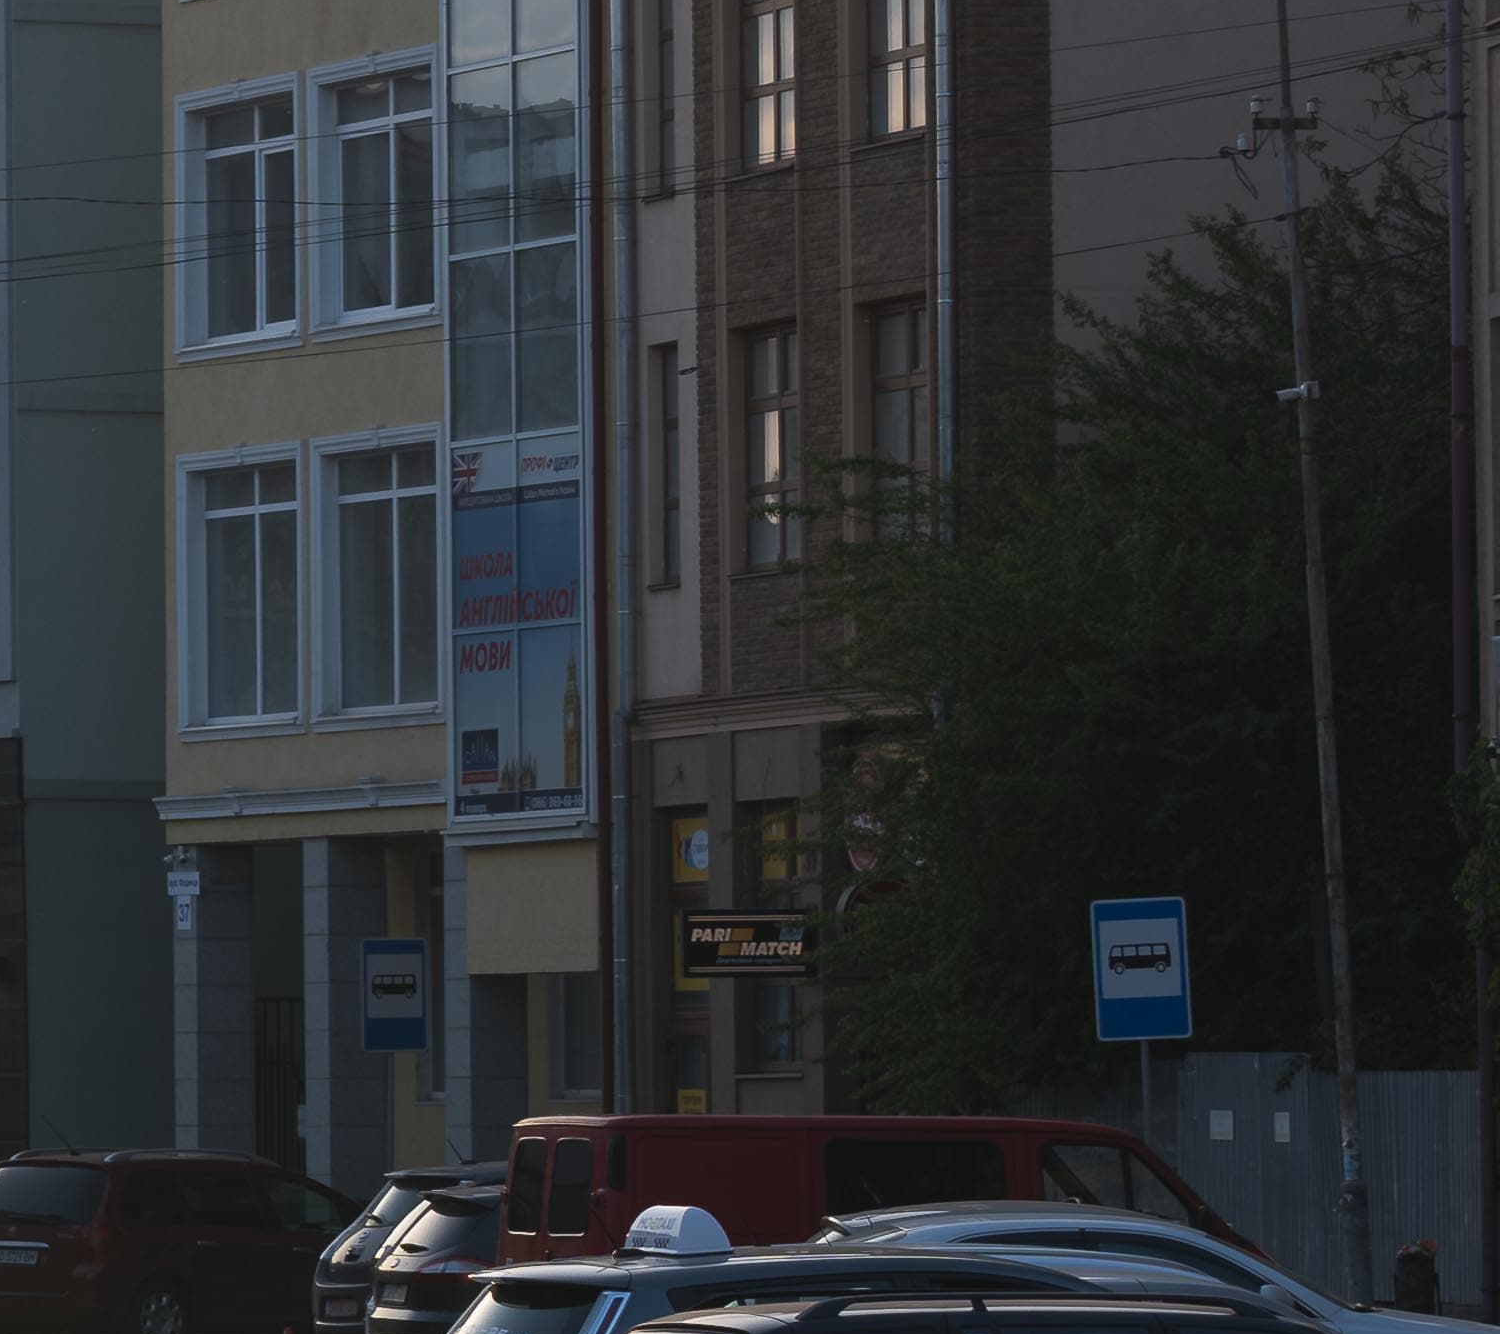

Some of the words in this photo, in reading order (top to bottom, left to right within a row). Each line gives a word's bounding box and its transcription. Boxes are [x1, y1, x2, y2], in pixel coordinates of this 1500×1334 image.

[460, 552, 512, 580] ШКОЛА
[460, 580, 576, 627] АНГЛІЙСЬКОЇ
[460, 639, 511, 674] МОВИ
[179, 904, 189, 922] 37
[691, 928, 732, 942] PARI
[740, 942, 802, 956] MATCH
